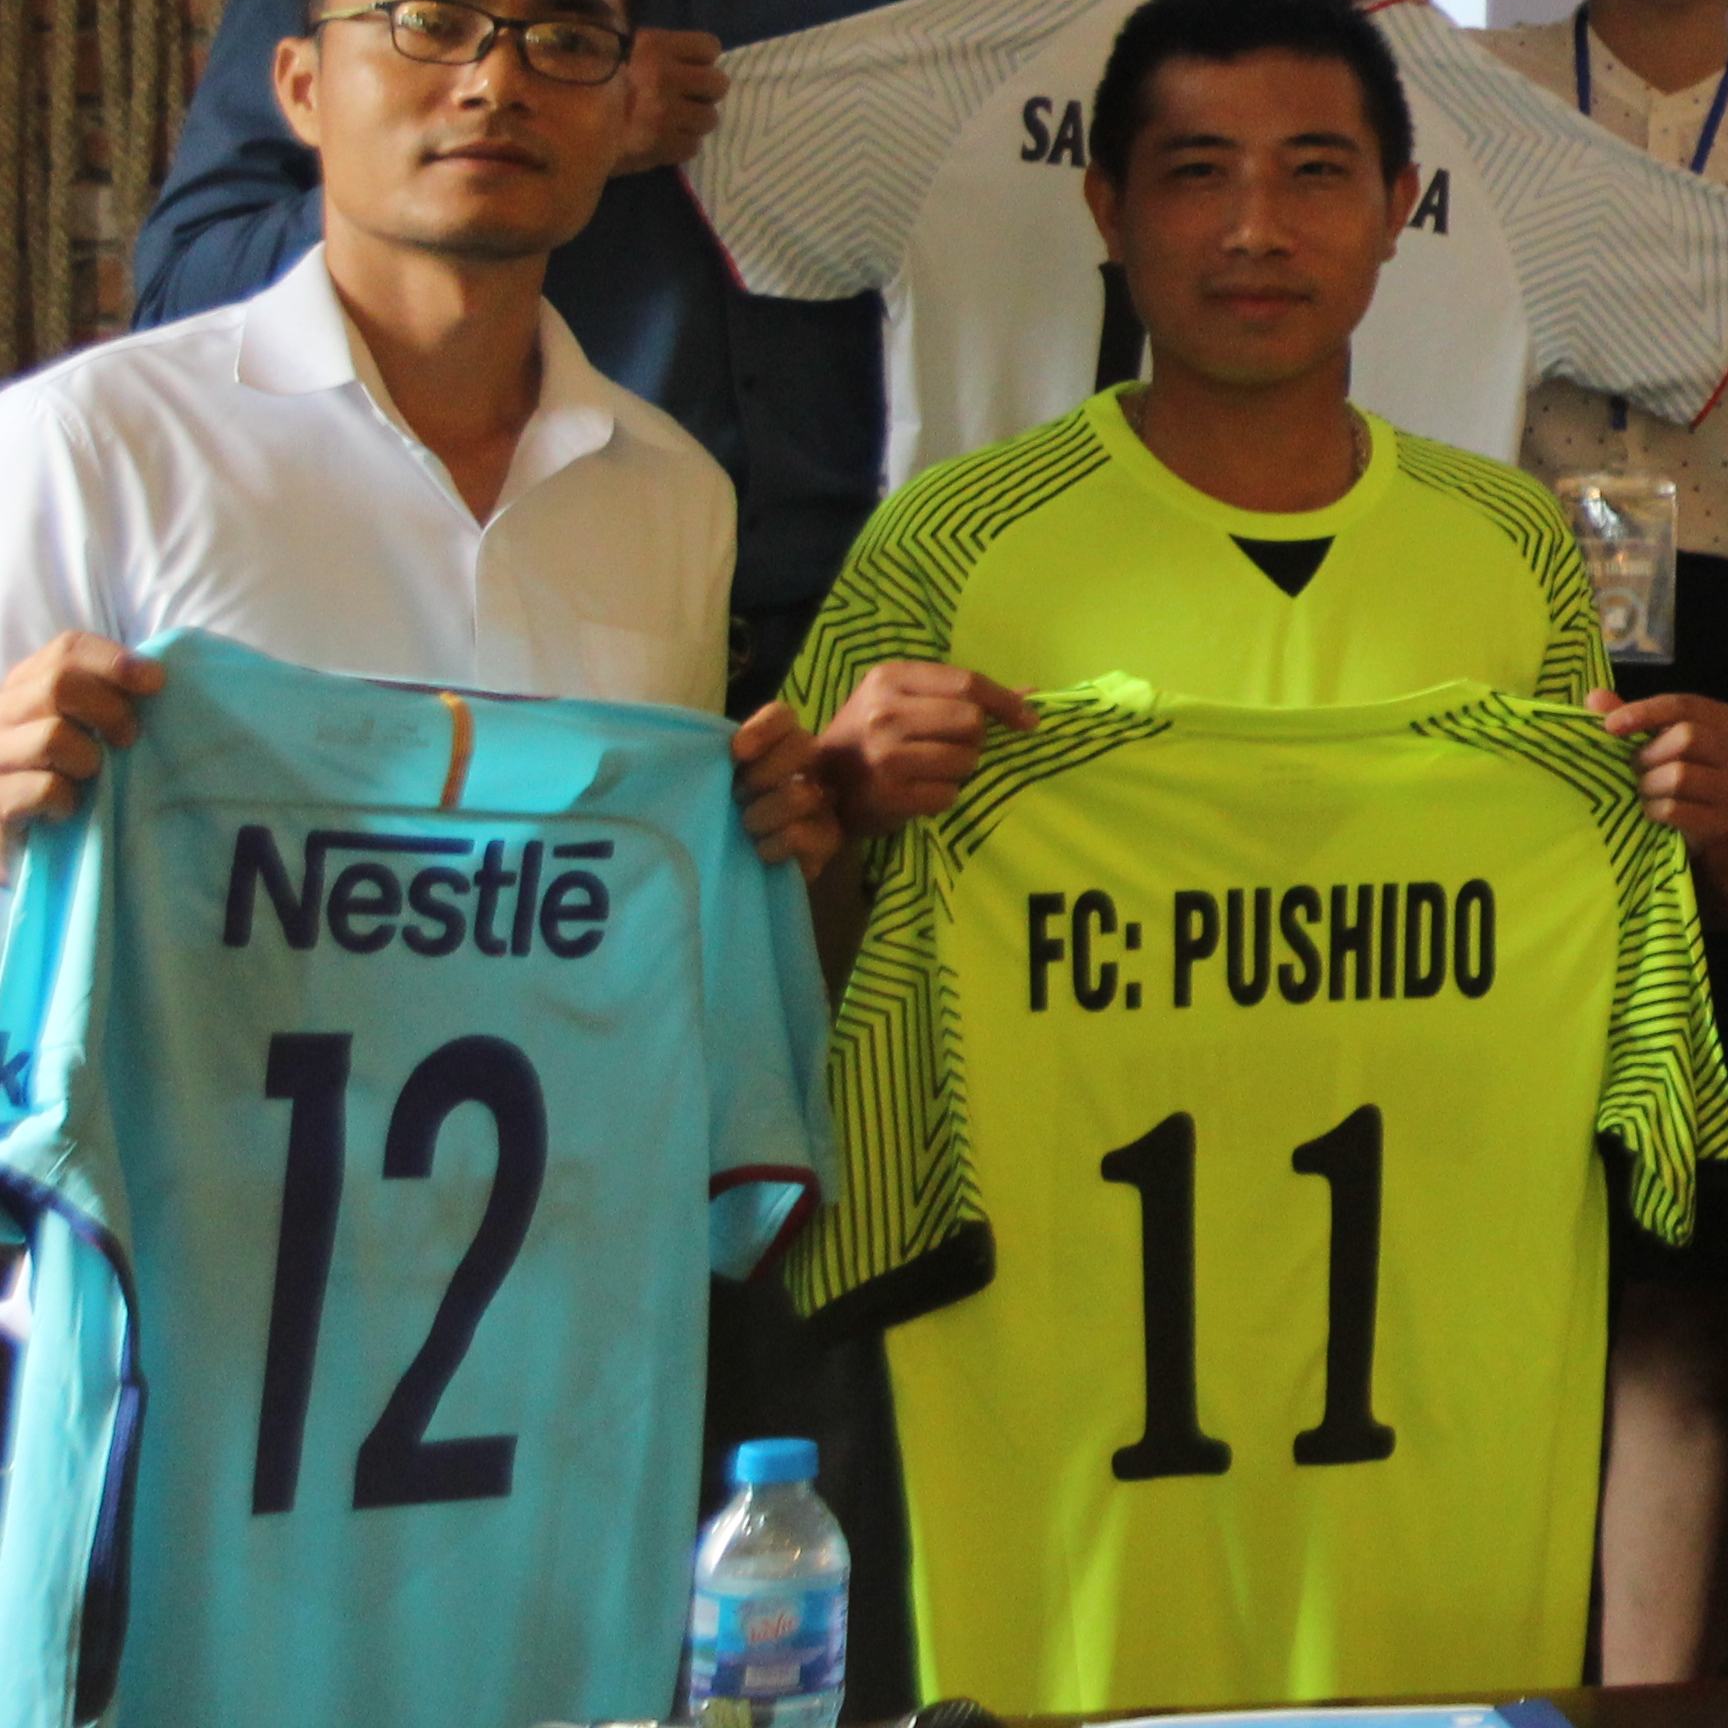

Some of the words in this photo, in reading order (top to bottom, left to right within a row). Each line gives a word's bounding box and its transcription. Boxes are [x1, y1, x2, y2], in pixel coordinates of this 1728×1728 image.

[1027, 889, 1143, 1013] FC:
[1174, 877, 1497, 1009] PUSHIDO
[251, 1032, 549, 1515] 12
[1101, 1102, 1397, 1482] 11
